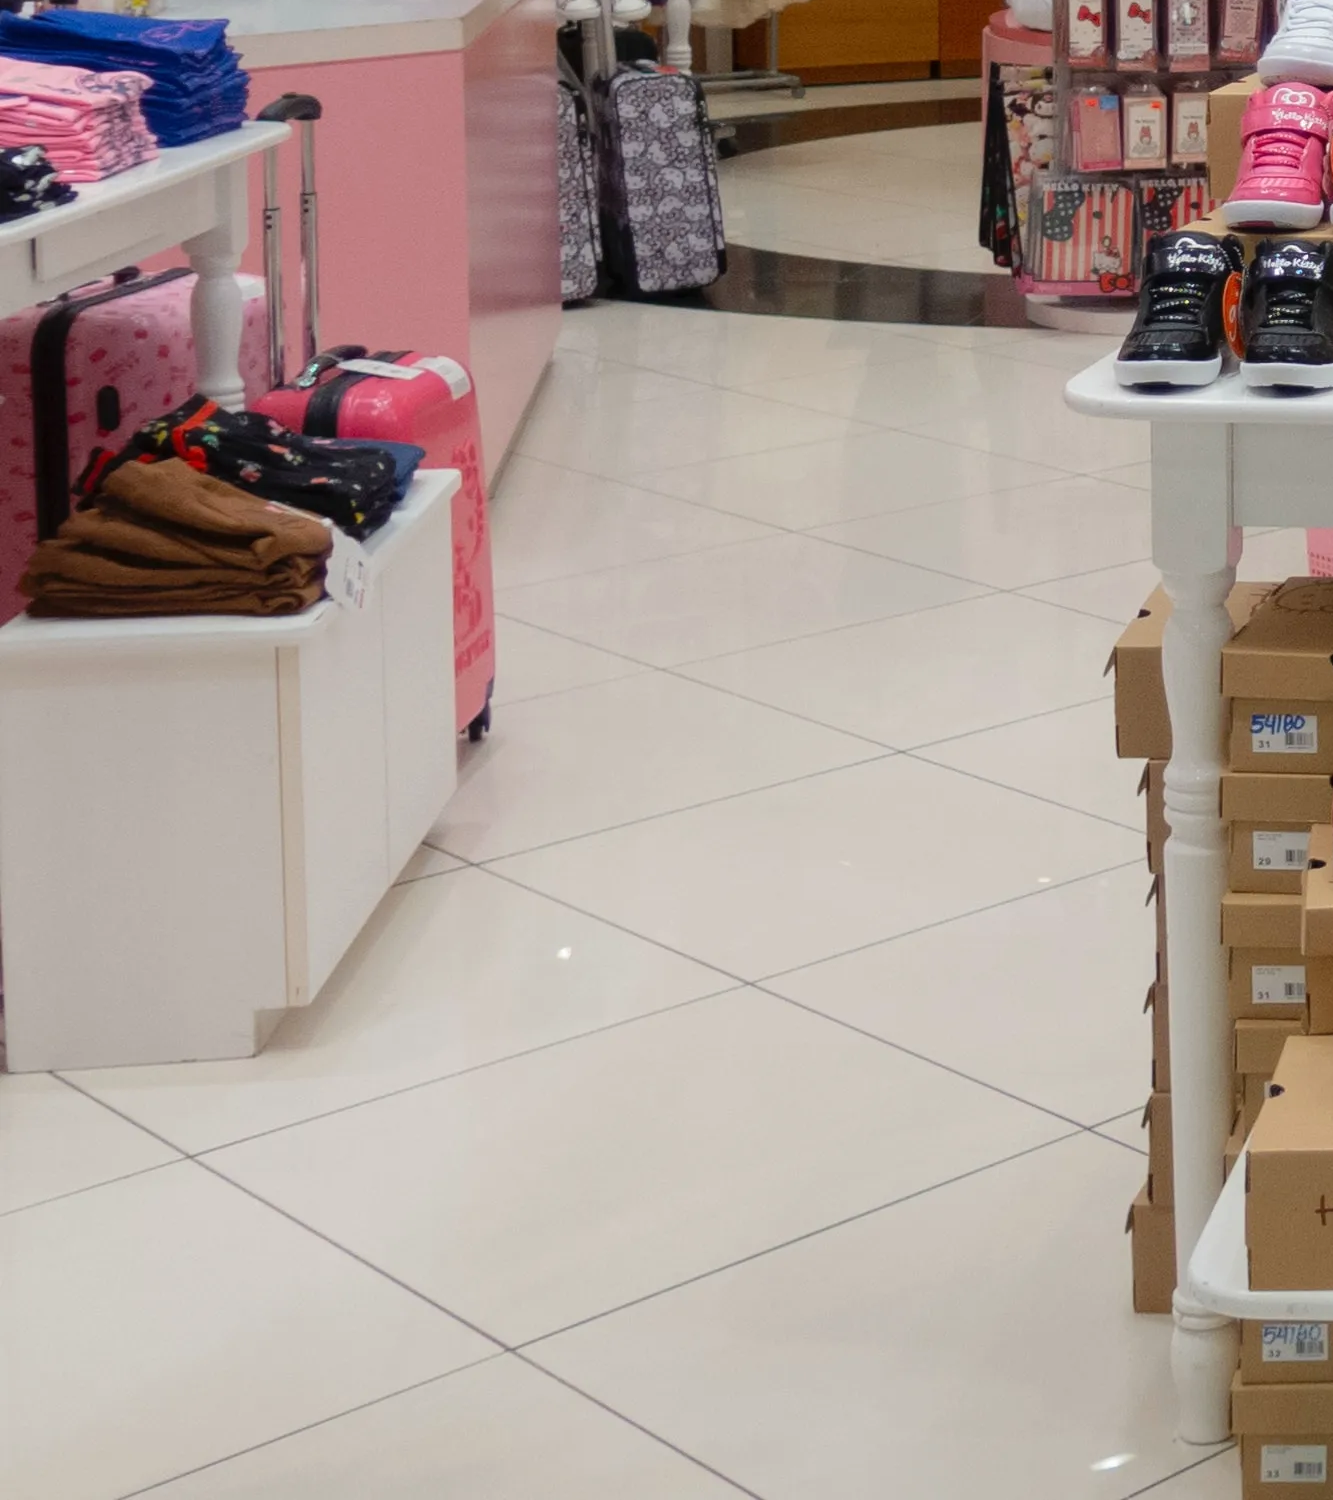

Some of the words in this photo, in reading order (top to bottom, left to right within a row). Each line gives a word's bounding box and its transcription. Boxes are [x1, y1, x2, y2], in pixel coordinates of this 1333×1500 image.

[1042, 181, 1081, 192] HELLO
[1081, 182, 1120, 193] KITTY
[1140, 179, 1177, 188] HELLO
[1263, 258, 1292, 269] Hello
[1258, 739, 1270, 749] 31
[1258, 856, 1271, 866] 29
[1257, 991, 1271, 1000] 31
[1267, 1350, 1281, 1358] 32
